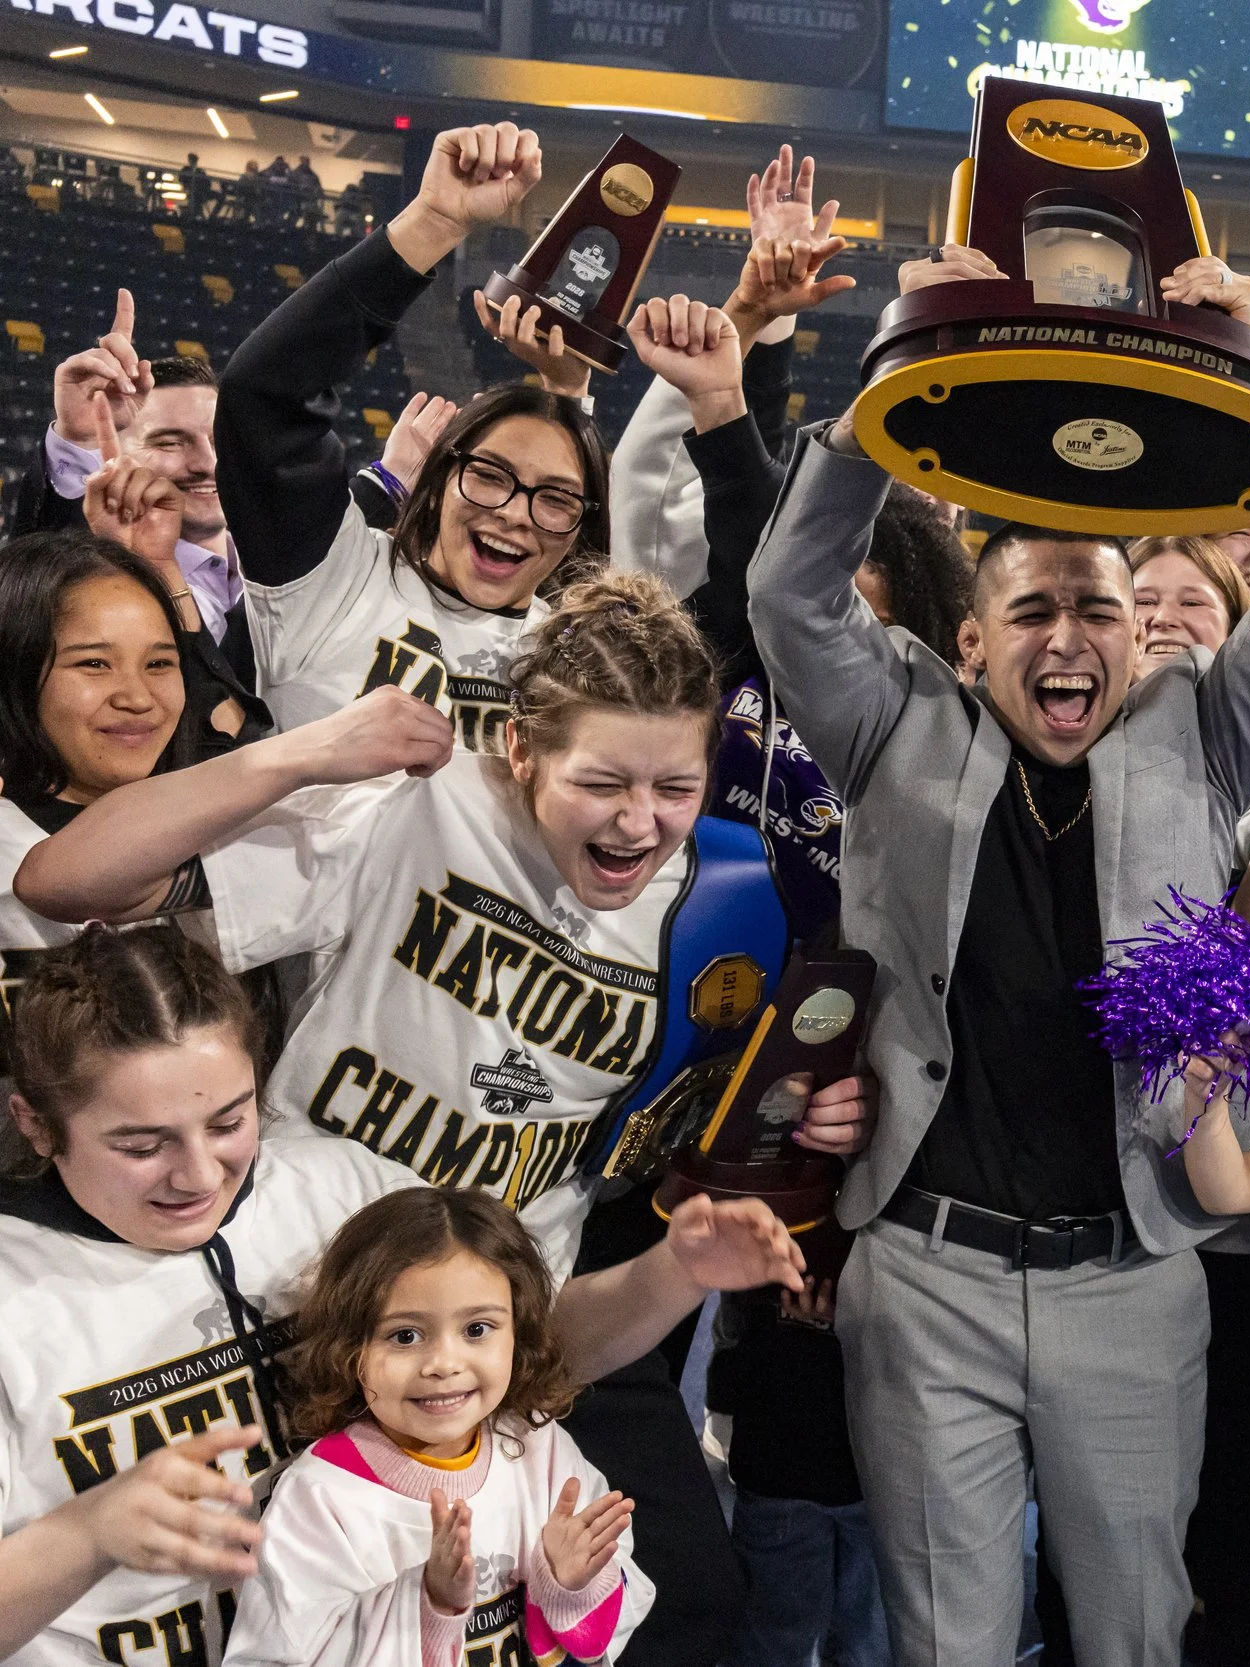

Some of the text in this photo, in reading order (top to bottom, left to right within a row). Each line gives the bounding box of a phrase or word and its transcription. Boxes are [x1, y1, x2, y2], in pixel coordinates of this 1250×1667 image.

[10, 0, 308, 69] RCATS
[572, 22, 666, 47] AWAITS
[1016, 39, 1150, 79] NATIONAL
[1022, 117, 1145, 157] NCAA
[602, 178, 648, 212] NCAA
[565, 283, 585, 296] 2026
[978, 326, 1233, 375] NATIONAL CHAMPION
[1066, 440, 1092, 450] MTM
[1067, 420, 1132, 436] Created Exclusively for
[1057, 447, 1073, 461] Official
[1073, 458, 1091, 467] Awards
[1114, 455, 1137, 467] Supplier
[473, 894, 507, 918] 2026
[506, 909, 541, 938] NCAA
[591, 961, 657, 992] WRESTLING
[392, 886, 654, 1077] NATIONA
[719, 970, 737, 1018] 131 LBS
[477, 1071, 552, 1097] CHAMPIONSHIPS
[500, 1066, 540, 1083] WRESTLING
[109, 1377, 158, 1407] 2026
[160, 1360, 209, 1389] NCAA
